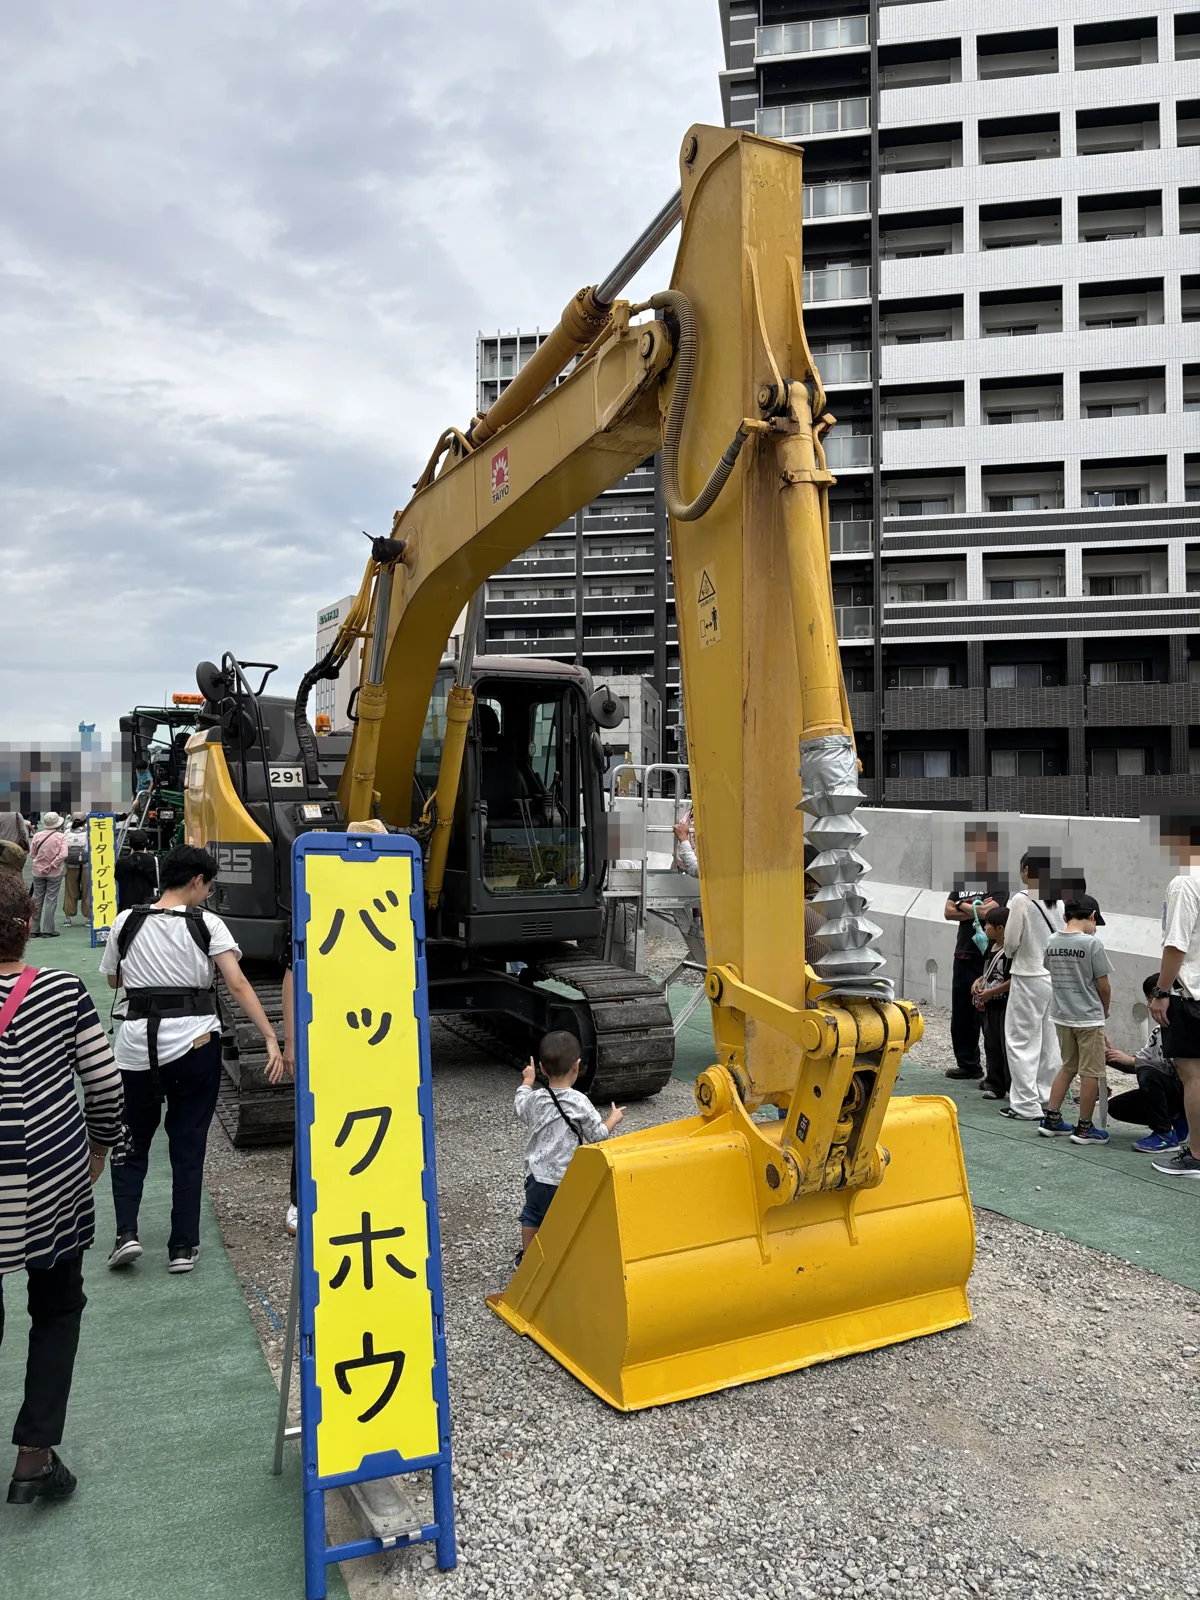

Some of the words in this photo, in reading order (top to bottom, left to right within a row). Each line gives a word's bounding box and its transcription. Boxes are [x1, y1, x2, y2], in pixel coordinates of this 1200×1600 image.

[492, 484, 510, 505] TAIYO
[94, 821, 113, 925] モーターグレーダー
[213, 848, 252, 872] 25
[318, 889, 417, 1423] バックホウ
